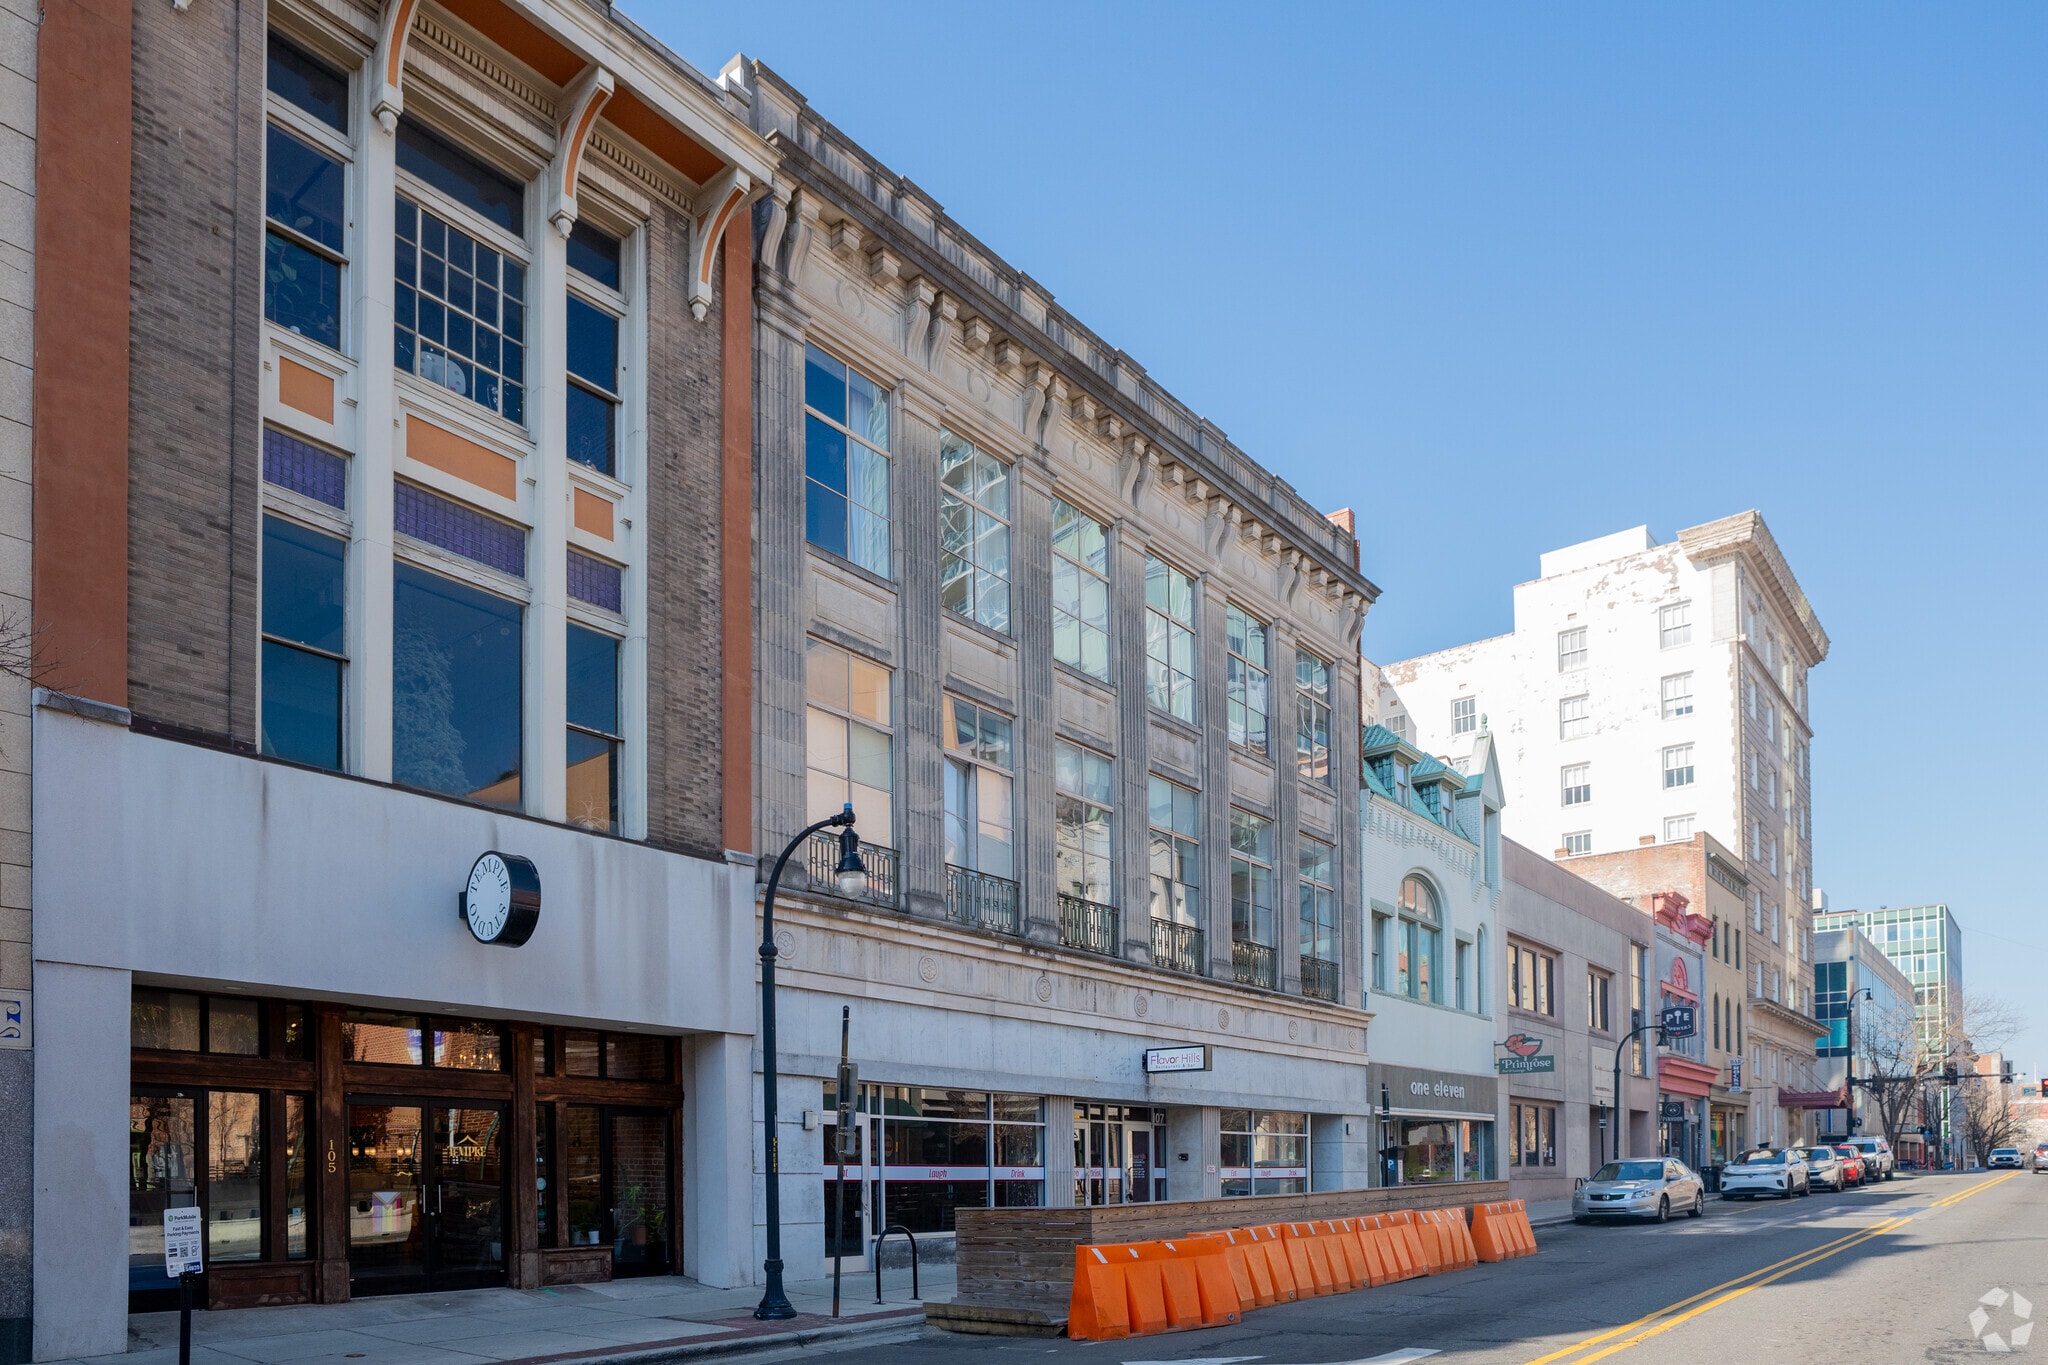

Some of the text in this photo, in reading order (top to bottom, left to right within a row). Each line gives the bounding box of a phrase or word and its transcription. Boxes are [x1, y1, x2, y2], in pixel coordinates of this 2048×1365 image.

[470, 858, 509, 893] TEMPLE
[469, 903, 507, 936] STUDIO
[1150, 1052, 1201, 1065] Flavor Hills
[1501, 1058, 1551, 1071] Primrose
[1410, 1081, 1465, 1099] one eleven
[327, 1139, 337, 1173] 105
[929, 1169, 948, 1180] Laugh
[1011, 1169, 1025, 1178] Drink
